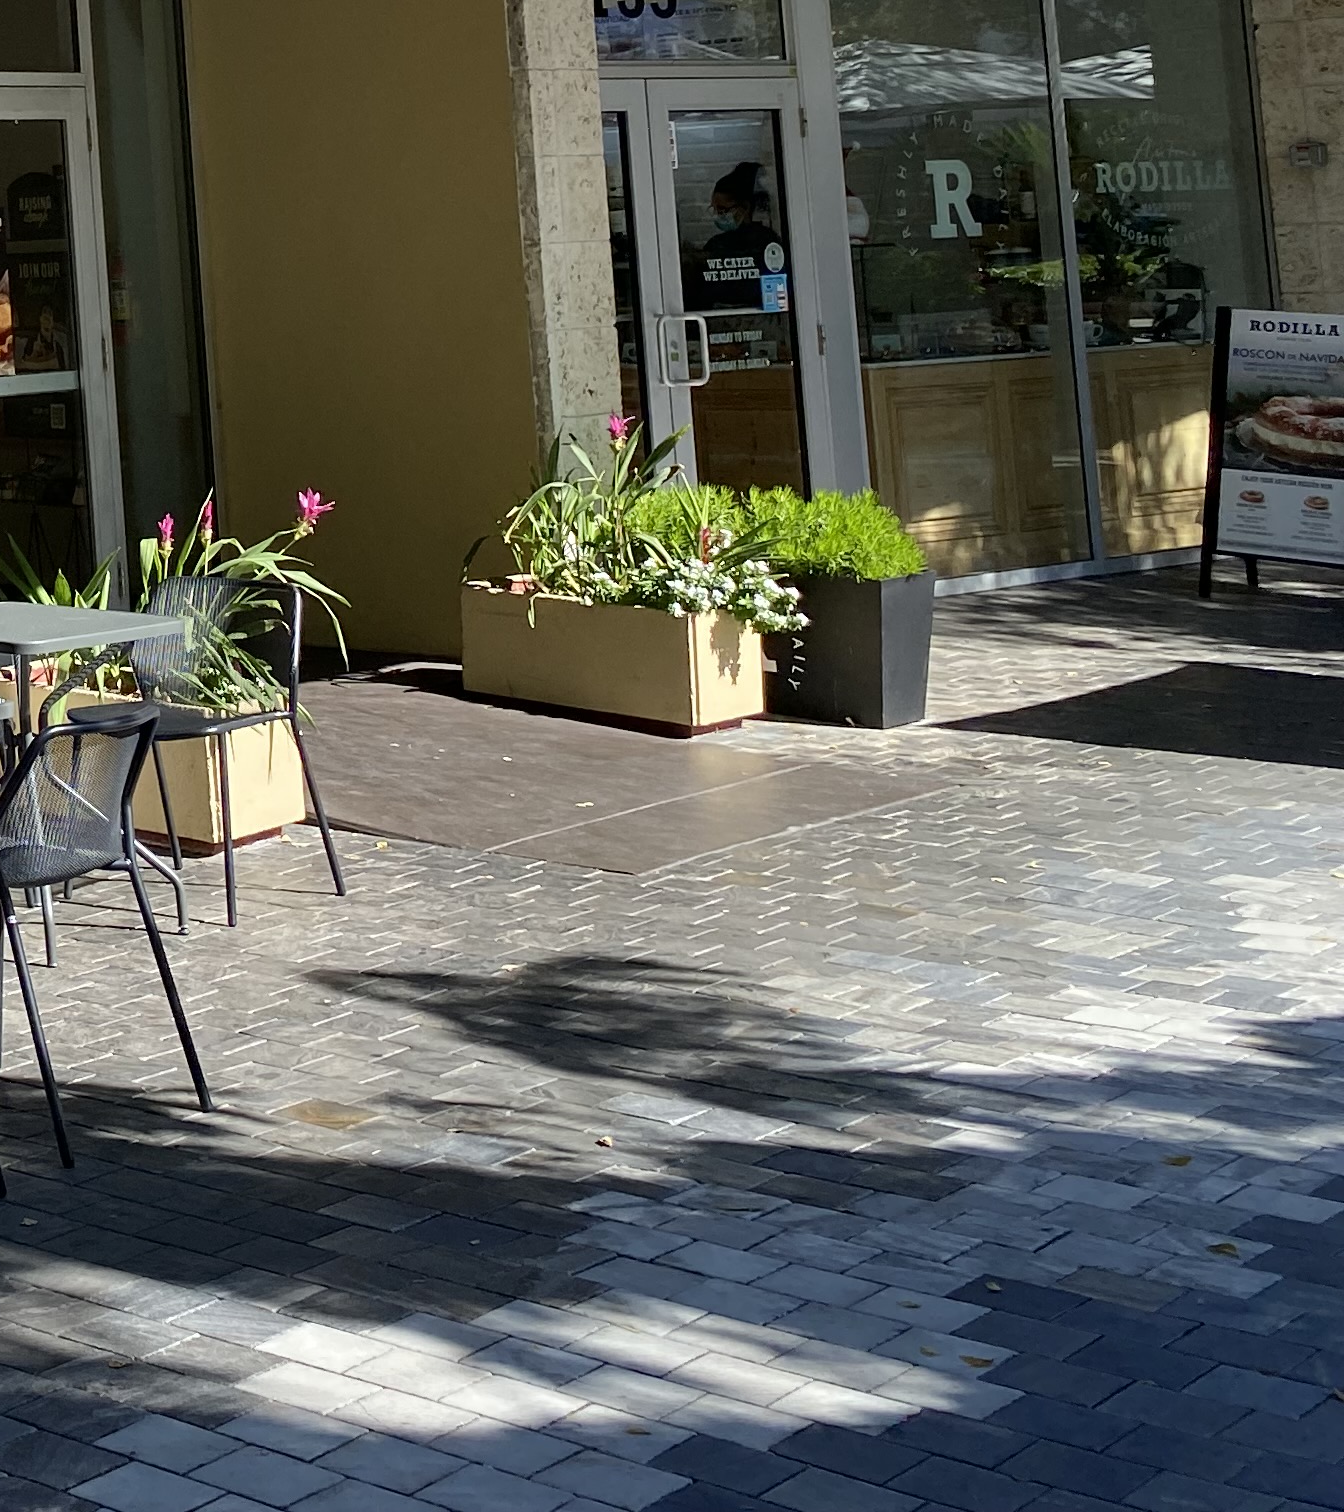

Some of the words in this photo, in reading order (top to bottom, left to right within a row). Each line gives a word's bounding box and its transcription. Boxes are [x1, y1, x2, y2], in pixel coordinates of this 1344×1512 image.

[1093, 159, 1233, 194] RODILLA
[924, 159, 983, 239] R
[703, 271, 719, 282] WE
[720, 269, 761, 281] DELIVER
[706, 259, 723, 270] WE
[723, 257, 756, 269] CATER
[1249, 319, 1341, 337] RODILLA
[787, 636, 807, 691] AILY
